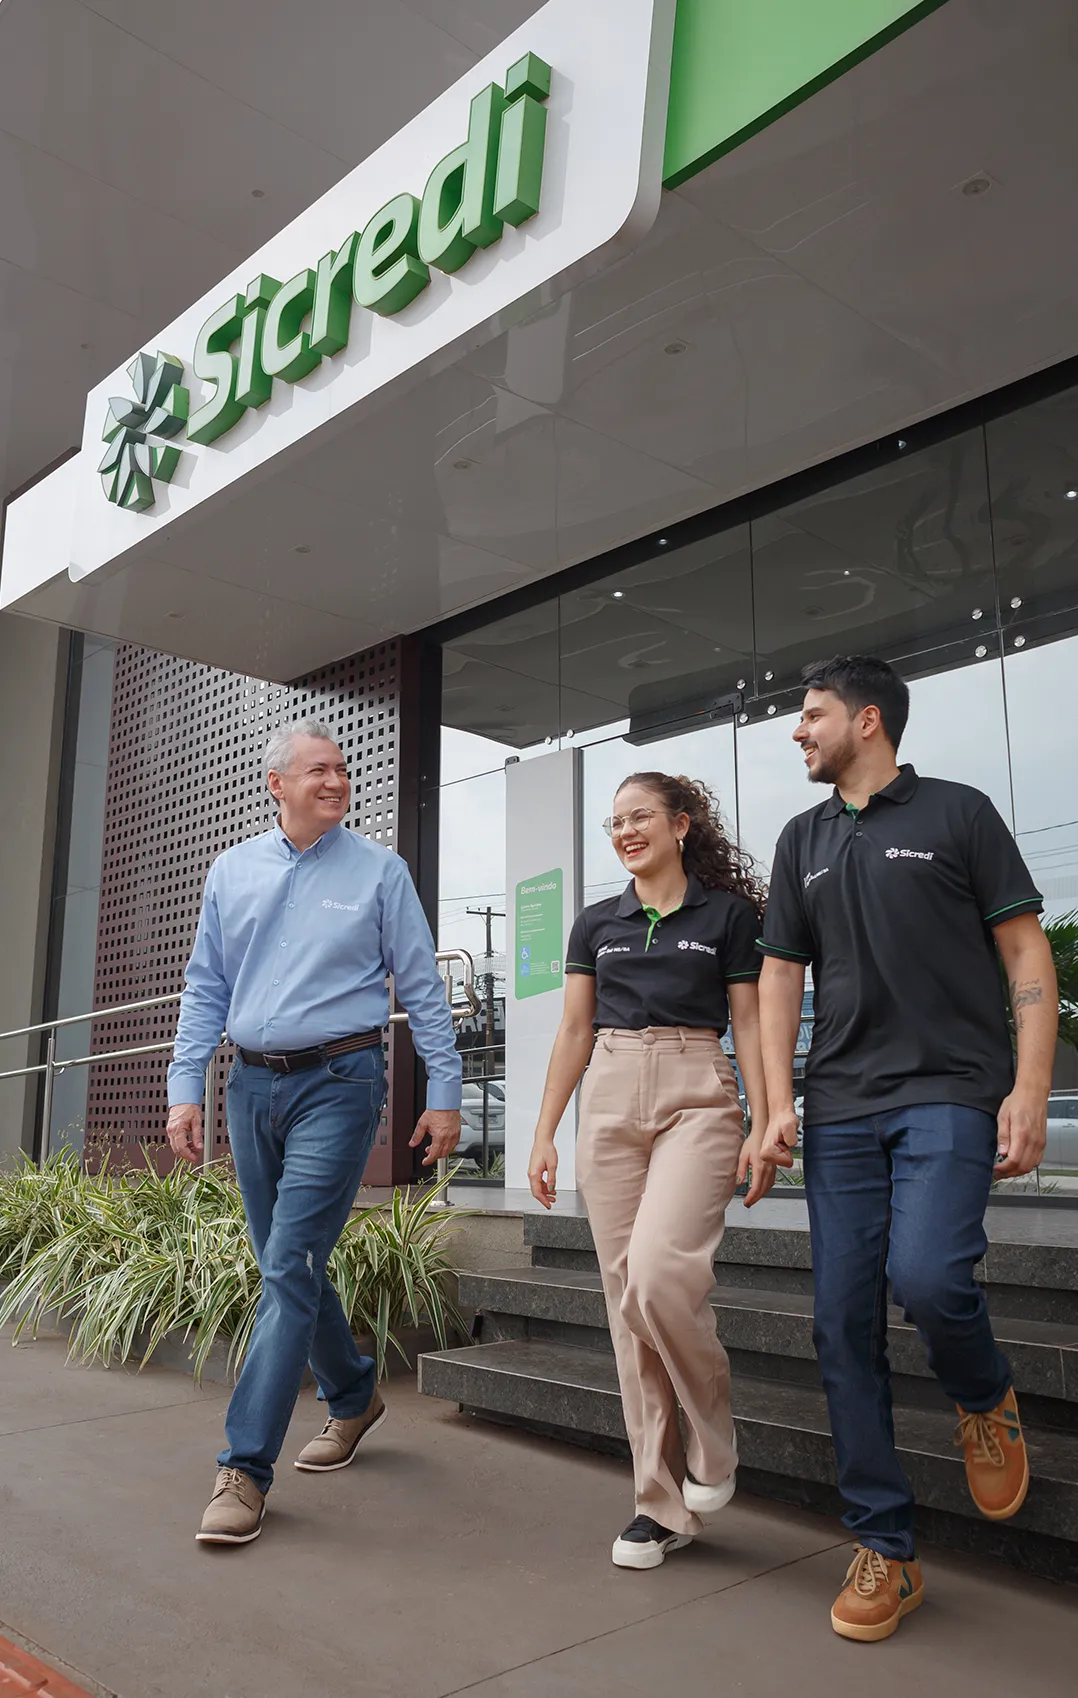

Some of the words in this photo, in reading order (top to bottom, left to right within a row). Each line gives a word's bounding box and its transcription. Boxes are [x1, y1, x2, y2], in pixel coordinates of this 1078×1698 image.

[187, 51, 552, 446] Sicredi
[900, 849, 934, 861] Sicredi
[520, 882, 557, 895] Bem-vindo
[332, 902, 360, 911] Sicredi
[689, 941, 717, 956] Sicredi
